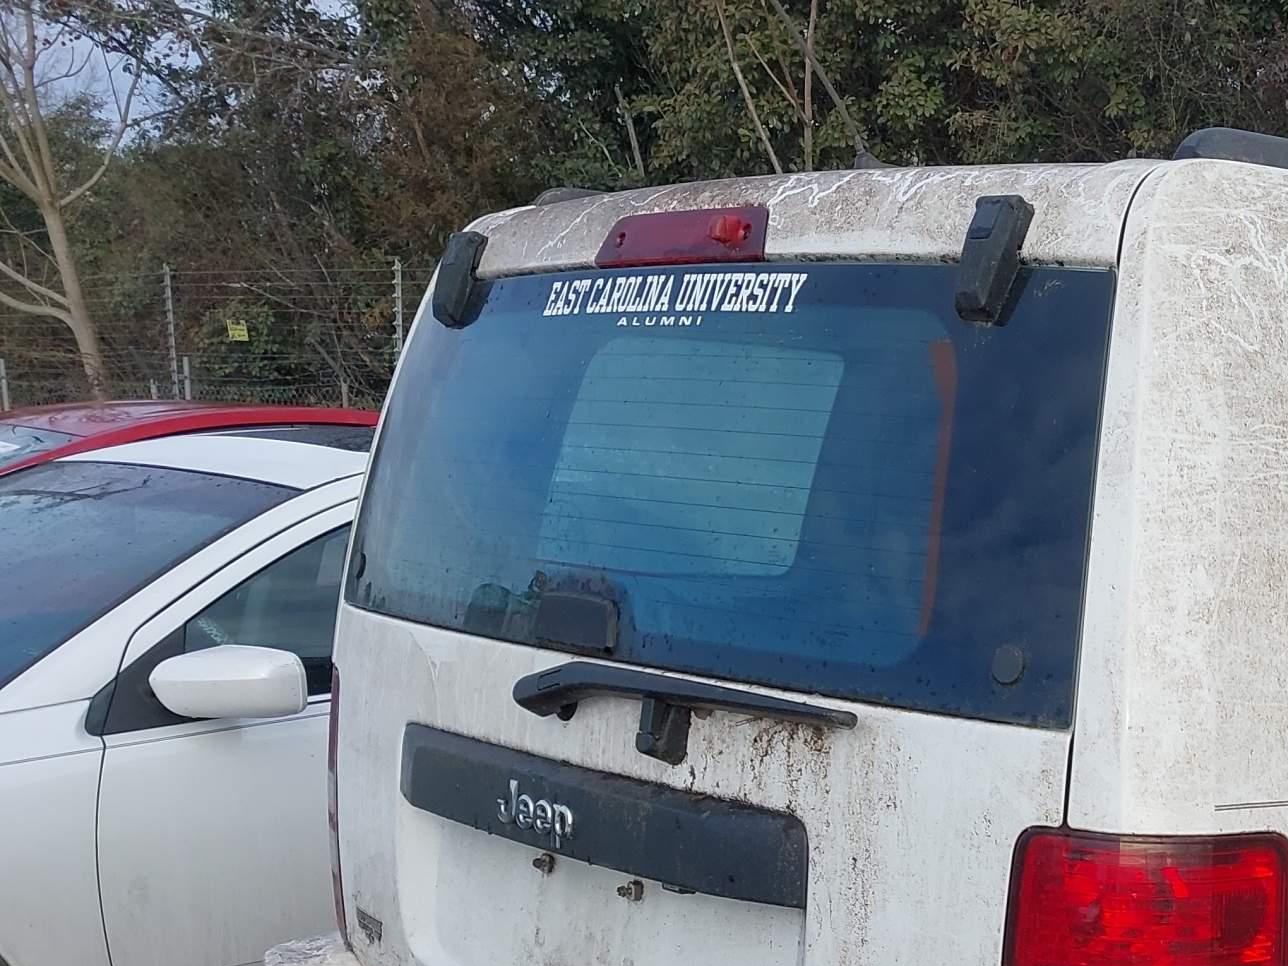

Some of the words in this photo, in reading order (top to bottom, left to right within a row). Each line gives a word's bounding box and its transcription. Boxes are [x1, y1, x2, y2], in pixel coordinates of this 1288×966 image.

[543, 279, 593, 316] EAST
[585, 275, 675, 314] CAROLINA
[674, 273, 808, 313] UNIVERSITY
[616, 315, 702, 327] ALUMNI
[496, 778, 573, 849] Jeep
